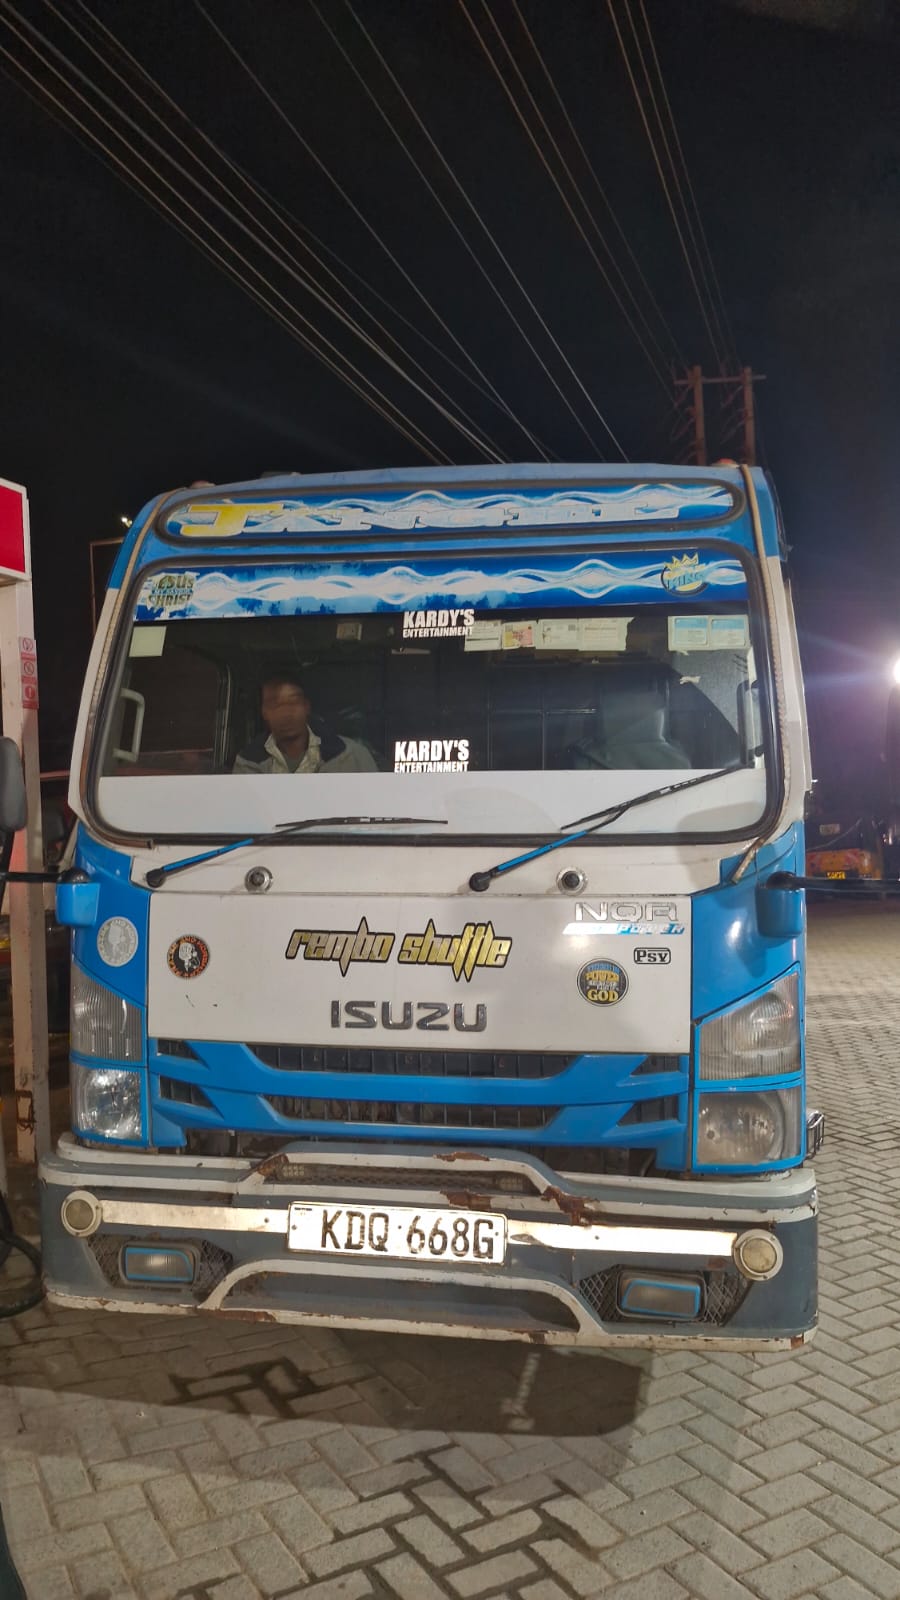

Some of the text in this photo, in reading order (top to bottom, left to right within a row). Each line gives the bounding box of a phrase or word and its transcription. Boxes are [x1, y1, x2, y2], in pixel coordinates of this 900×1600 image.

[403, 608, 475, 628] KARDY'S
[402, 626, 473, 638] ENTERTAINMENT
[394, 739, 470, 762] KARDY'S
[394, 761, 469, 773] ENTERTAINMENT
[575, 902, 679, 923] NQR
[285, 916, 512, 982] rembo shuffle
[587, 989, 619, 1002] GOD
[331, 1000, 488, 1032] ISUZU
[321, 1209, 495, 1260] KDQ 668G
